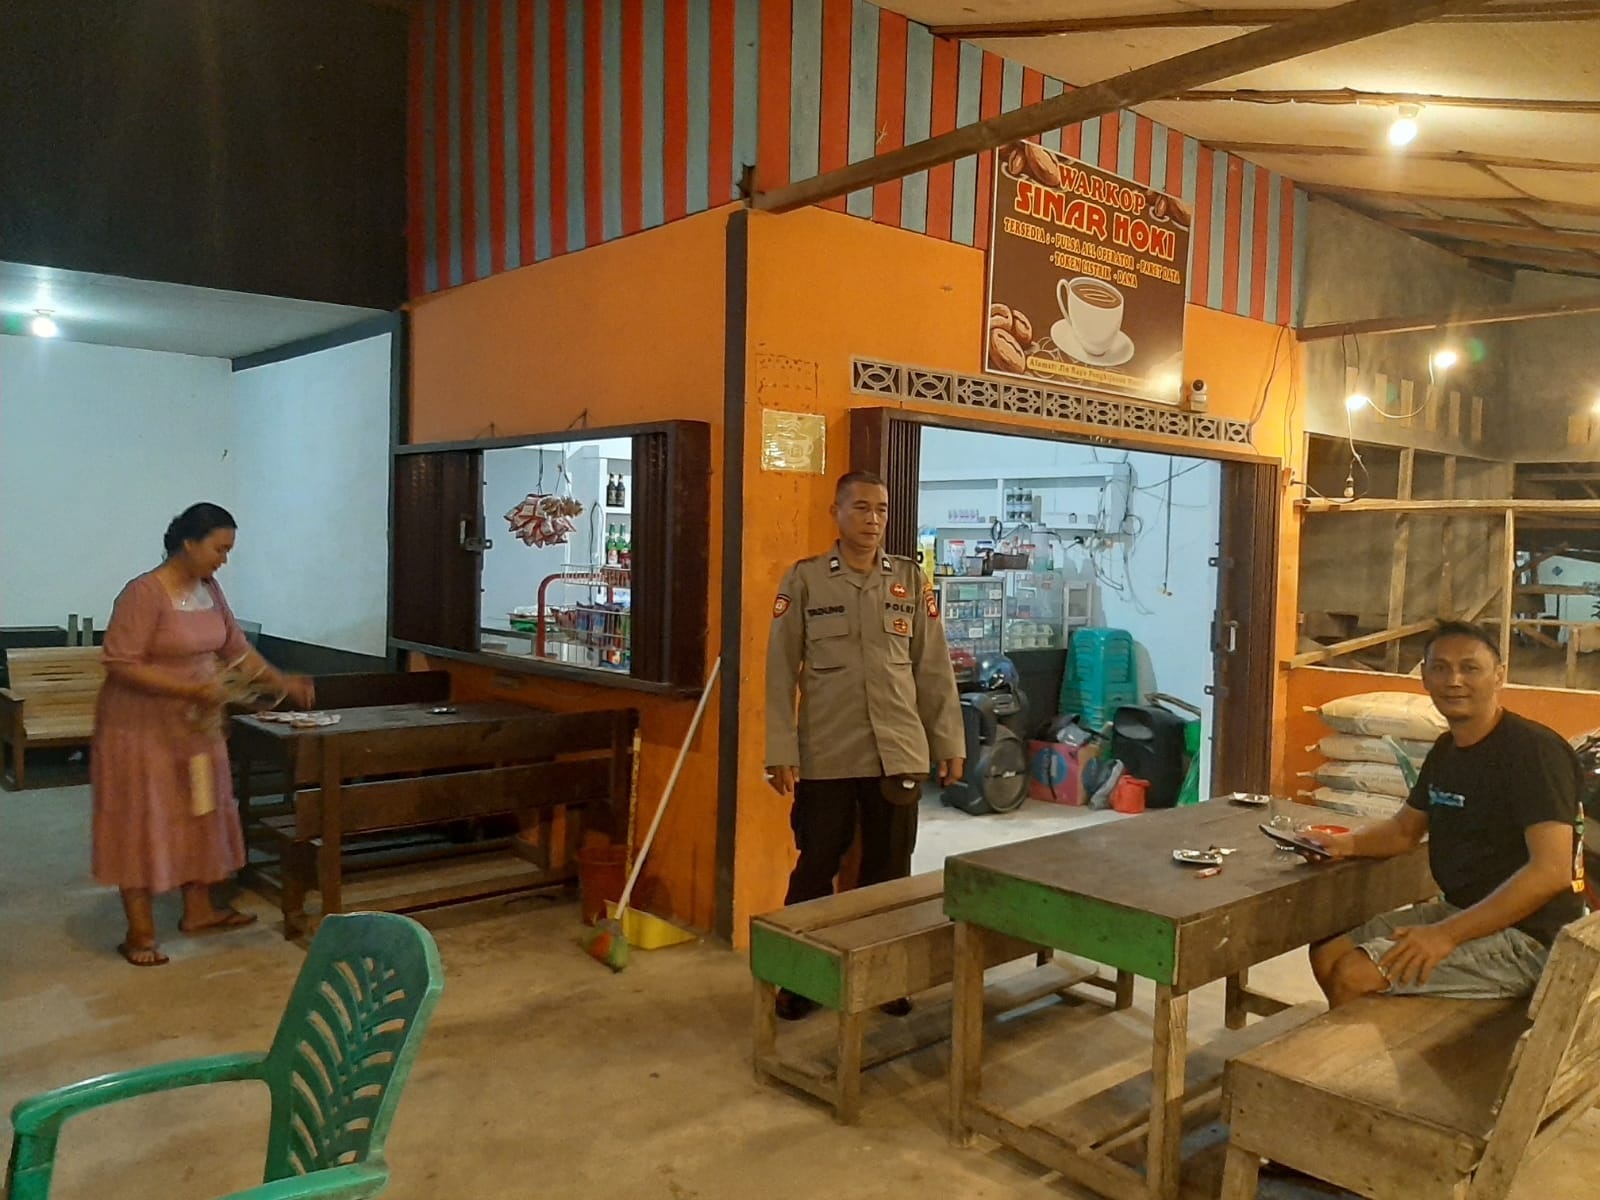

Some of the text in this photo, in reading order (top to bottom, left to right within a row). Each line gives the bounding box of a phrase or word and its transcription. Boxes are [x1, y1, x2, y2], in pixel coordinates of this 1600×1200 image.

[1058, 163, 1146, 215] WARKOP
[1015, 178, 1176, 261] SINAR HOKI
[1055, 251, 1081, 272] TOKEN
[1082, 259, 1112, 281] LISTRIK
[1117, 270, 1138, 289] DANA
[1081, 241, 1096, 259] ALL
[1097, 246, 1135, 270] OPERATOR
[1162, 266, 1181, 285] DATA
[885, 602, 914, 614] POLRI
